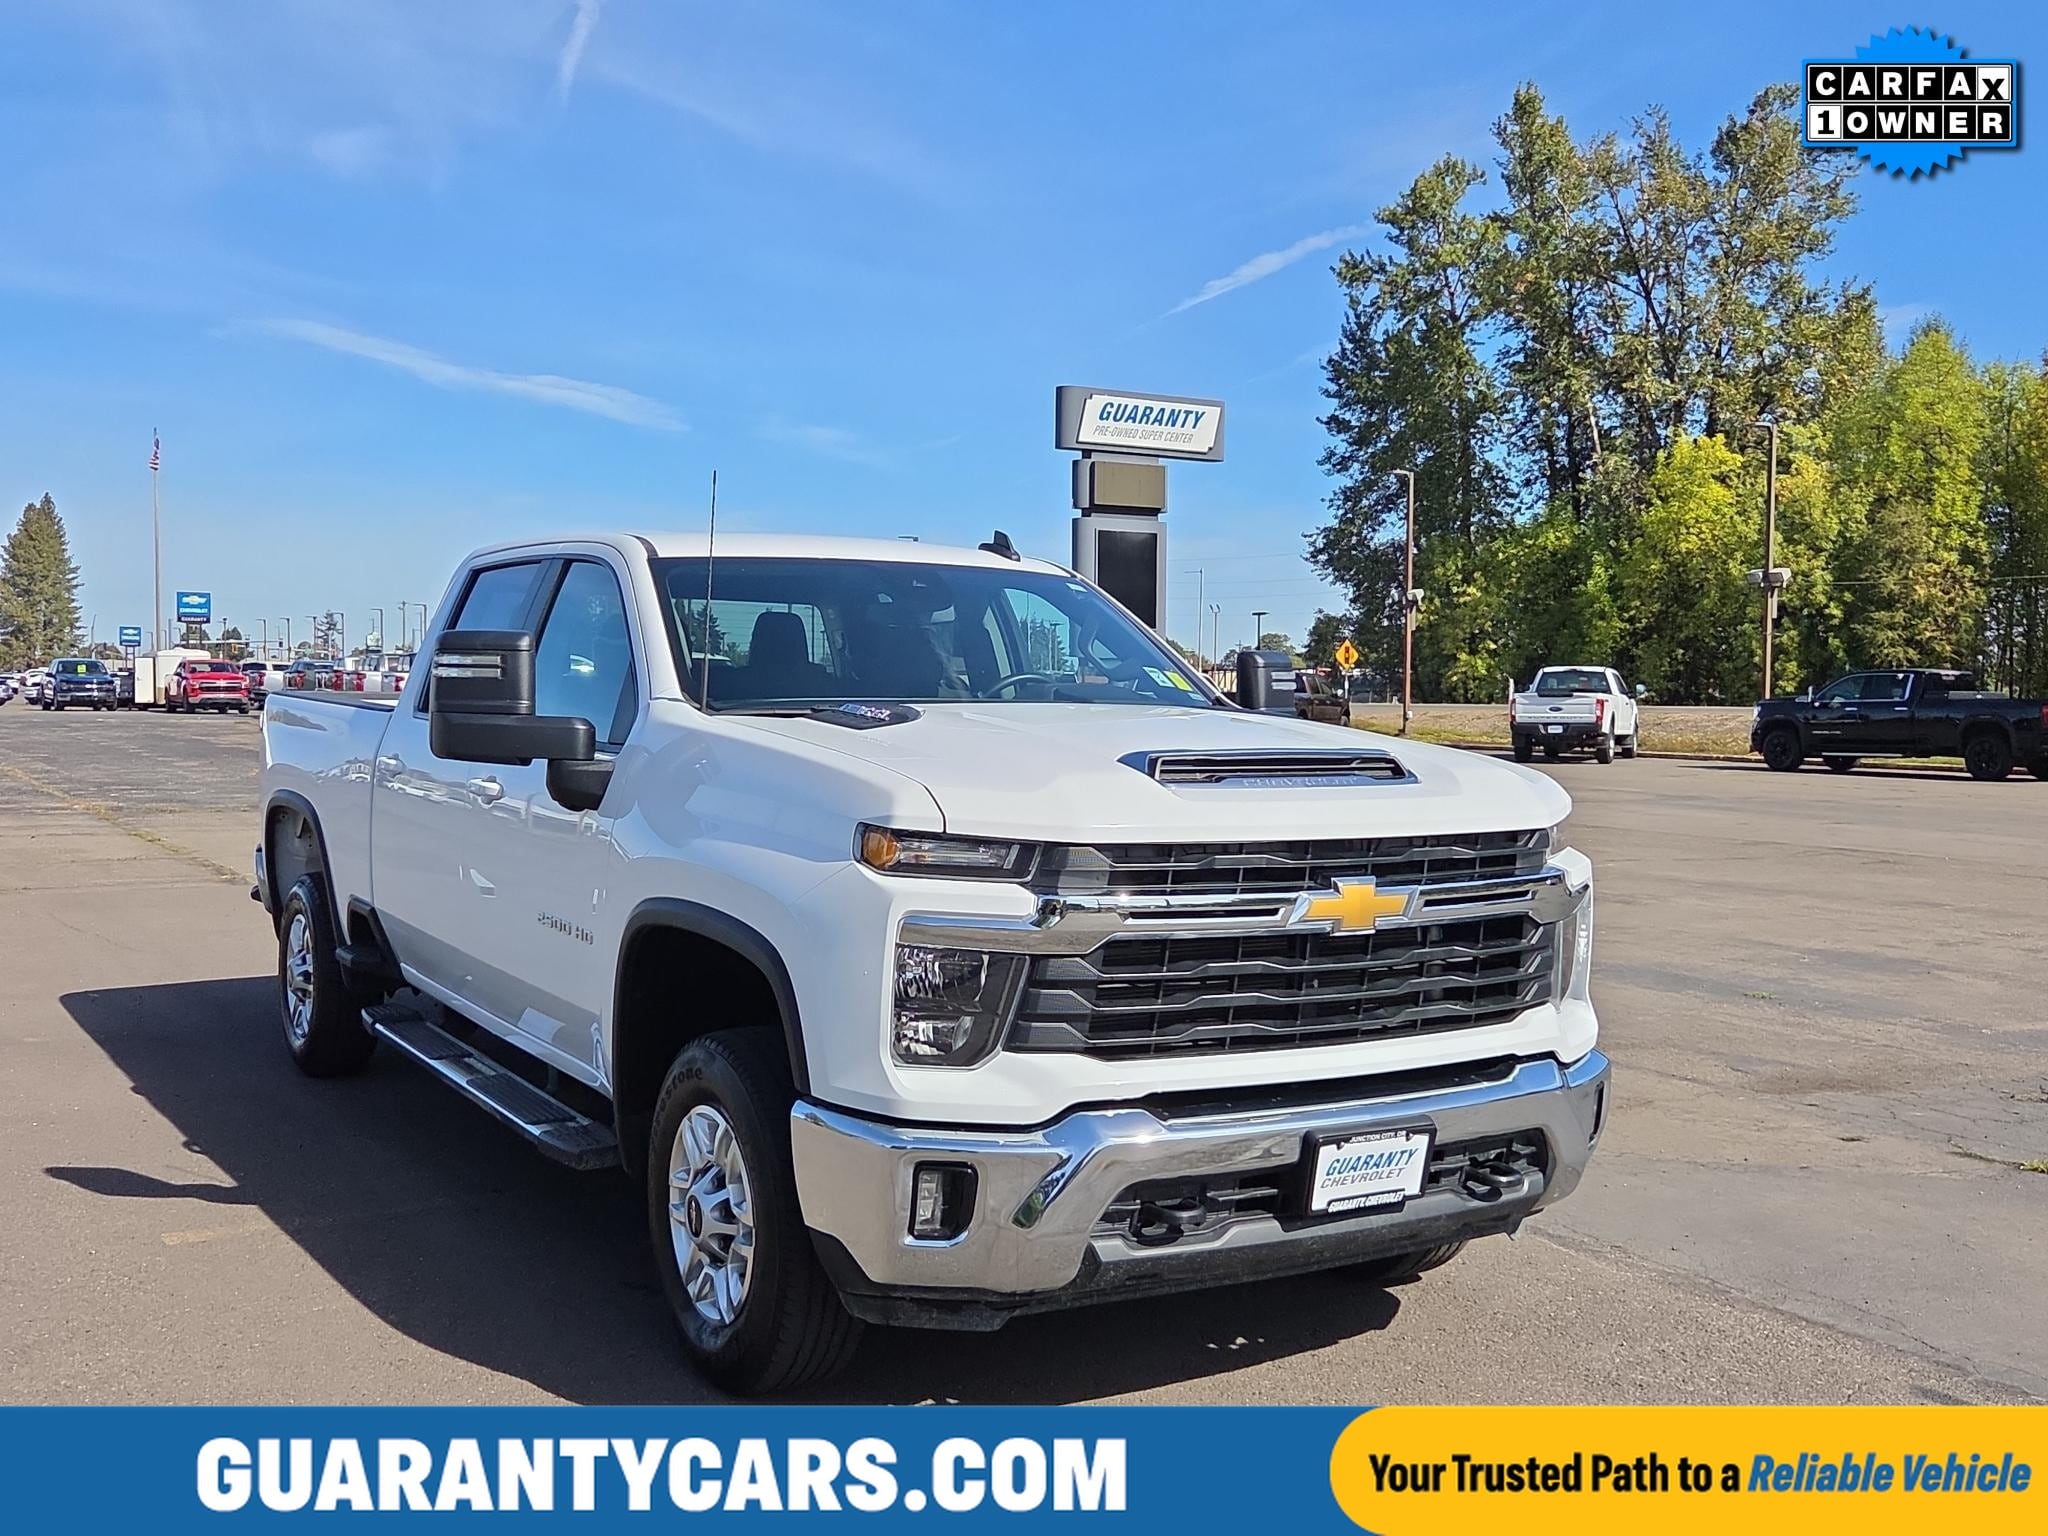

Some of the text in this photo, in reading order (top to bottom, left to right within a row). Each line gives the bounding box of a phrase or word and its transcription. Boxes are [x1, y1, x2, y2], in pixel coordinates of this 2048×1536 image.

[1099, 402, 1205, 429] GUARANTY
[1092, 424, 1194, 444] PRE-OWNED SUPER CENTER
[1325, 1148, 1418, 1176] GUARANTY
[1320, 1167, 1405, 1189] CHEVROLET
